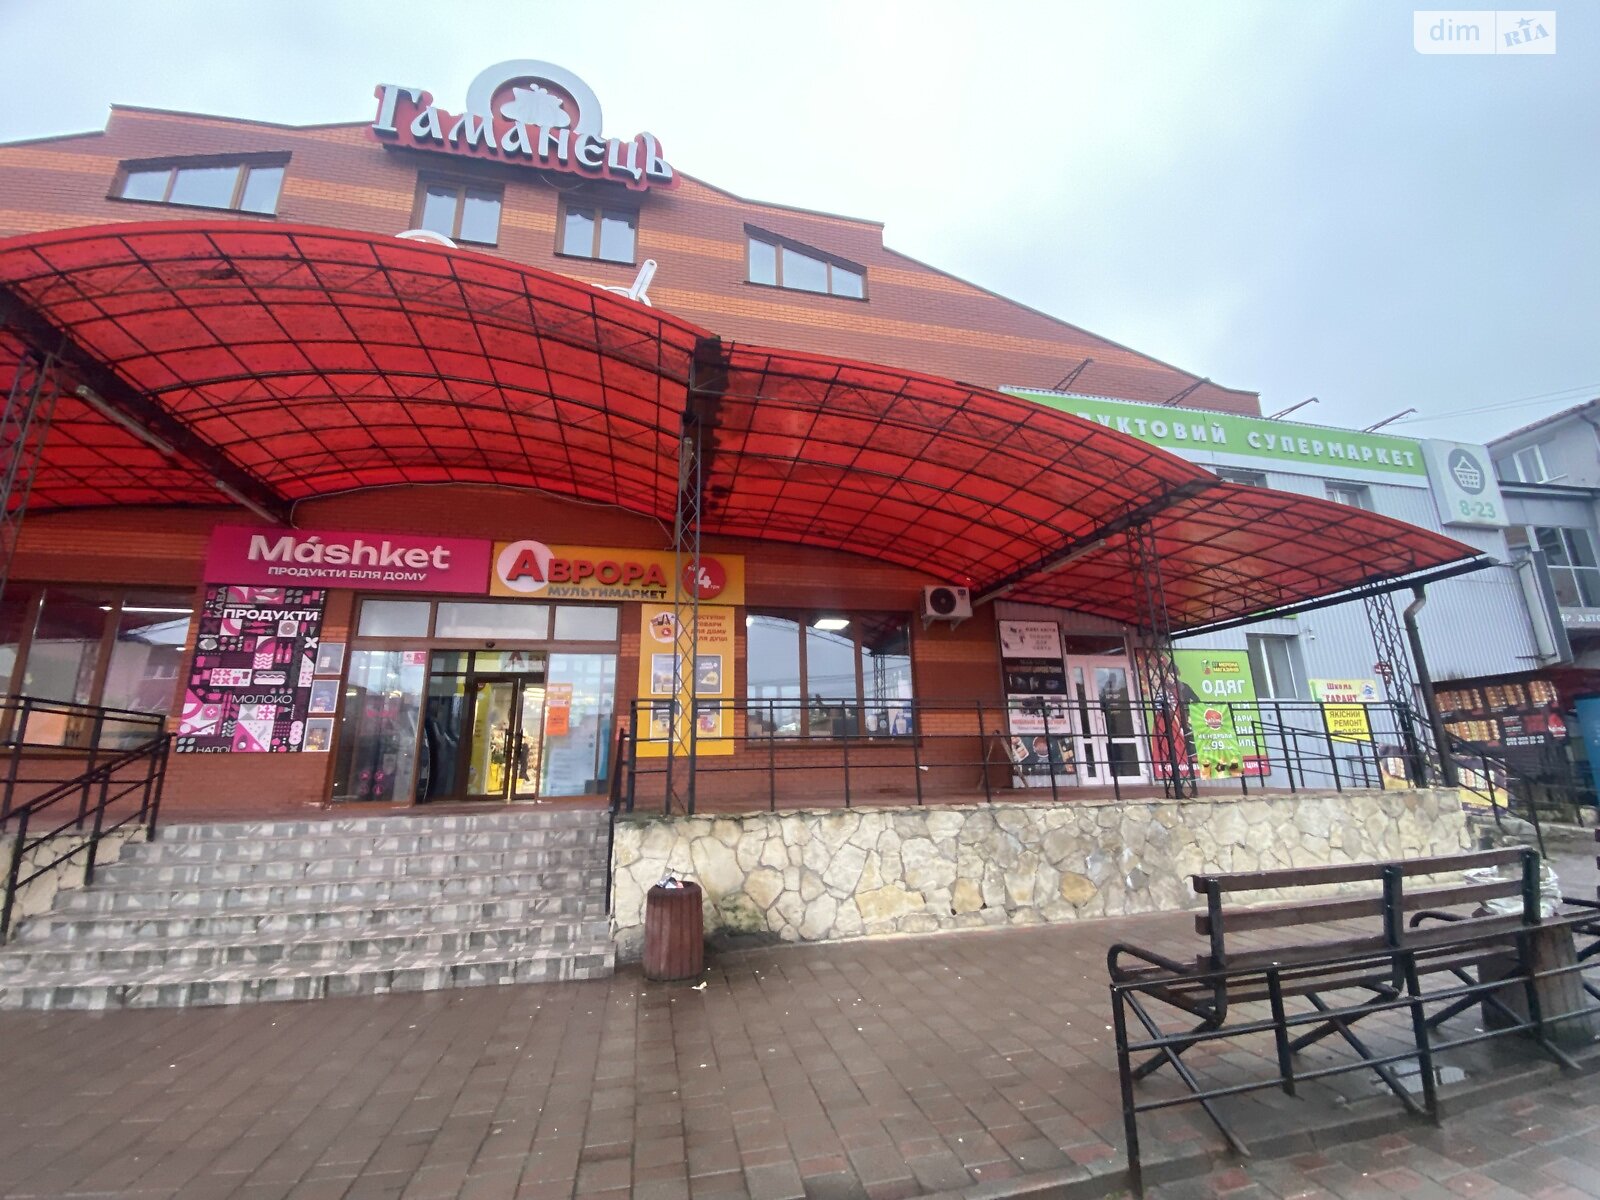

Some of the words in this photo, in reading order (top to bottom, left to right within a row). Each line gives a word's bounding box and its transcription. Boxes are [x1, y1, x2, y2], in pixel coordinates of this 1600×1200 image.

[1247, 431, 1414, 468] СУПЕРМАРКЕТ
[1458, 500, 1496, 519] 8-23
[267, 566, 347, 579] ПРОДУКТИ
[349, 570, 382, 580] БІЛЯ
[382, 571, 427, 581] ДОМУ
[547, 588, 667, 600] МУЛЬТИМАРКЕТ
[222, 608, 319, 621] ПРОДУКТИ
[1201, 679, 1246, 697] ОДЯГ
[231, 694, 293, 705] МОЛОКО
[1333, 719, 1363, 727] РЕМОНТ
